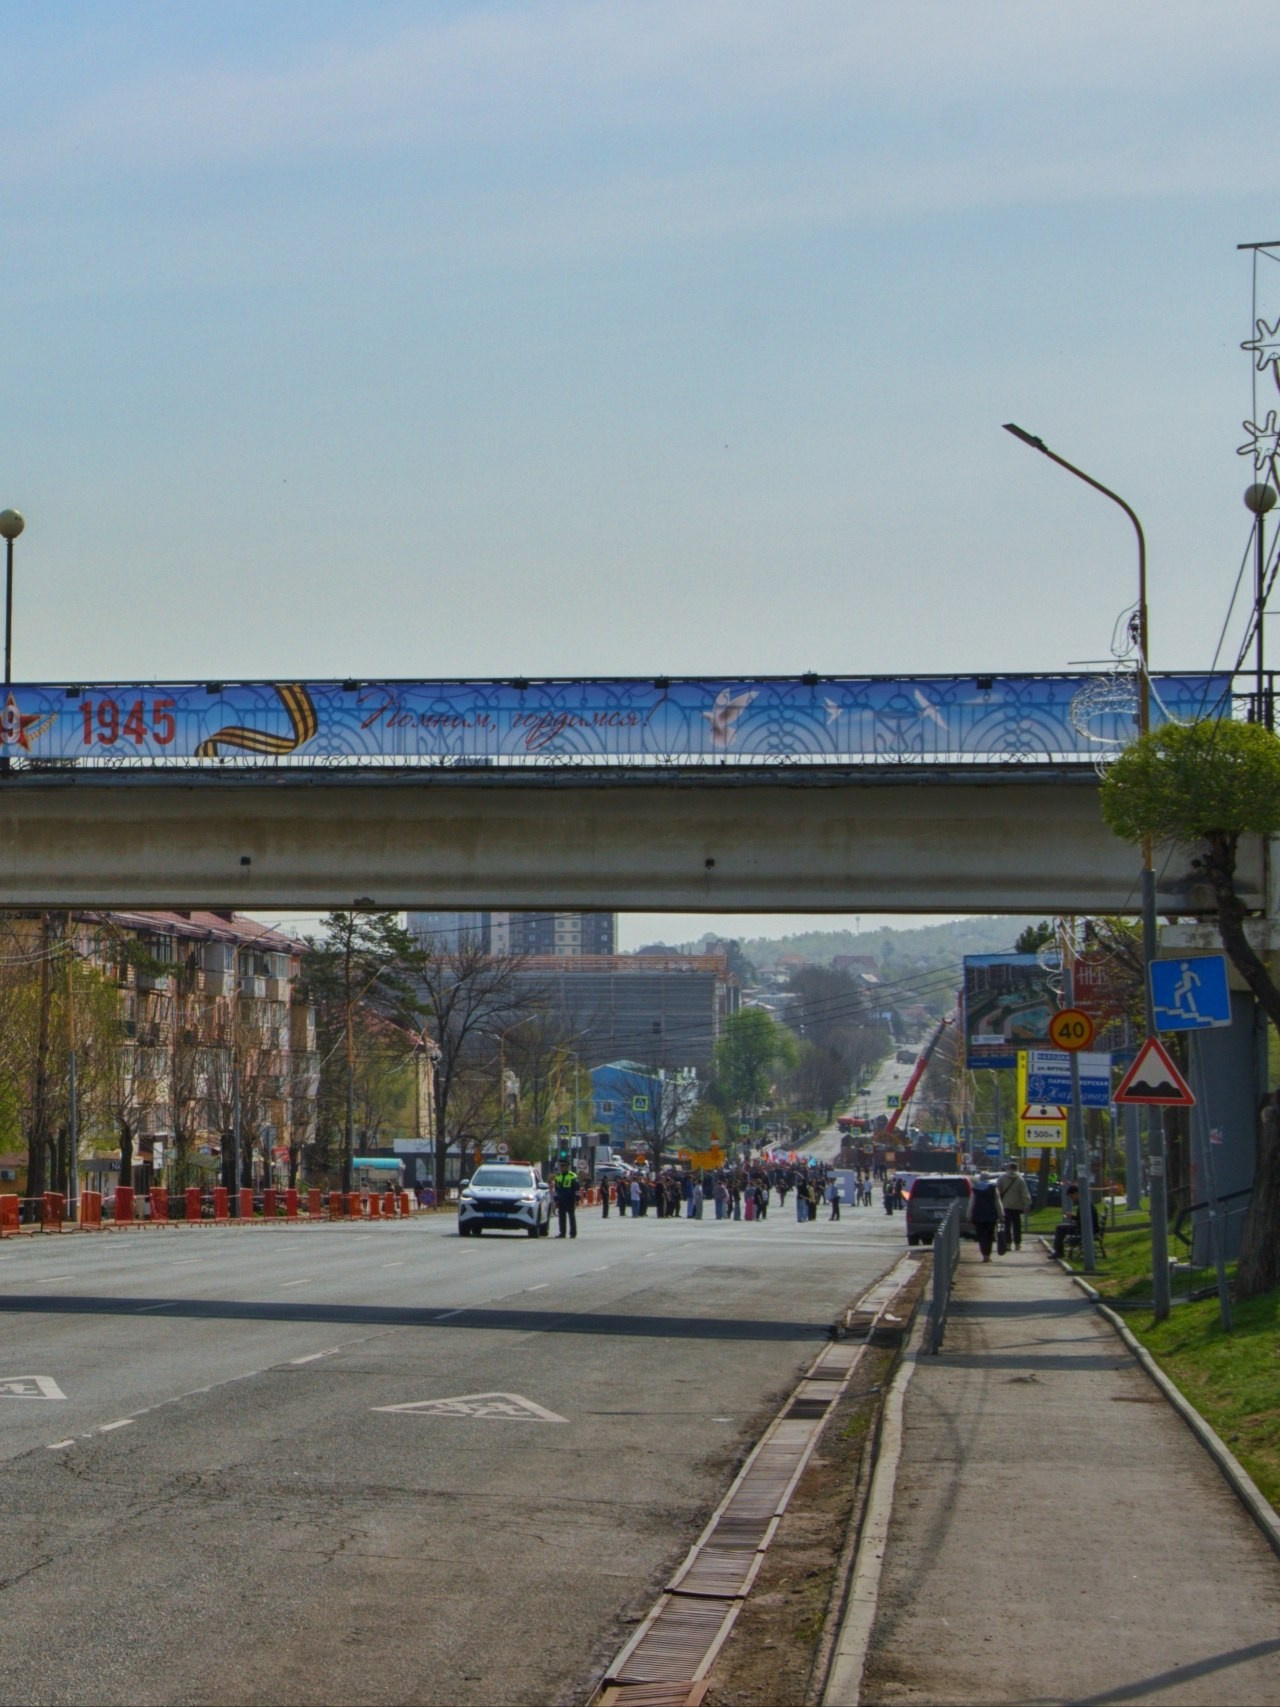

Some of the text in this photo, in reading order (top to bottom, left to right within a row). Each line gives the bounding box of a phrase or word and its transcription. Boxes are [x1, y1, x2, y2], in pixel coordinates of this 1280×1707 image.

[0, 704, 20, 744] 9
[78, 699, 177, 746] 1945
[1059, 1022, 1084, 1039] 40
